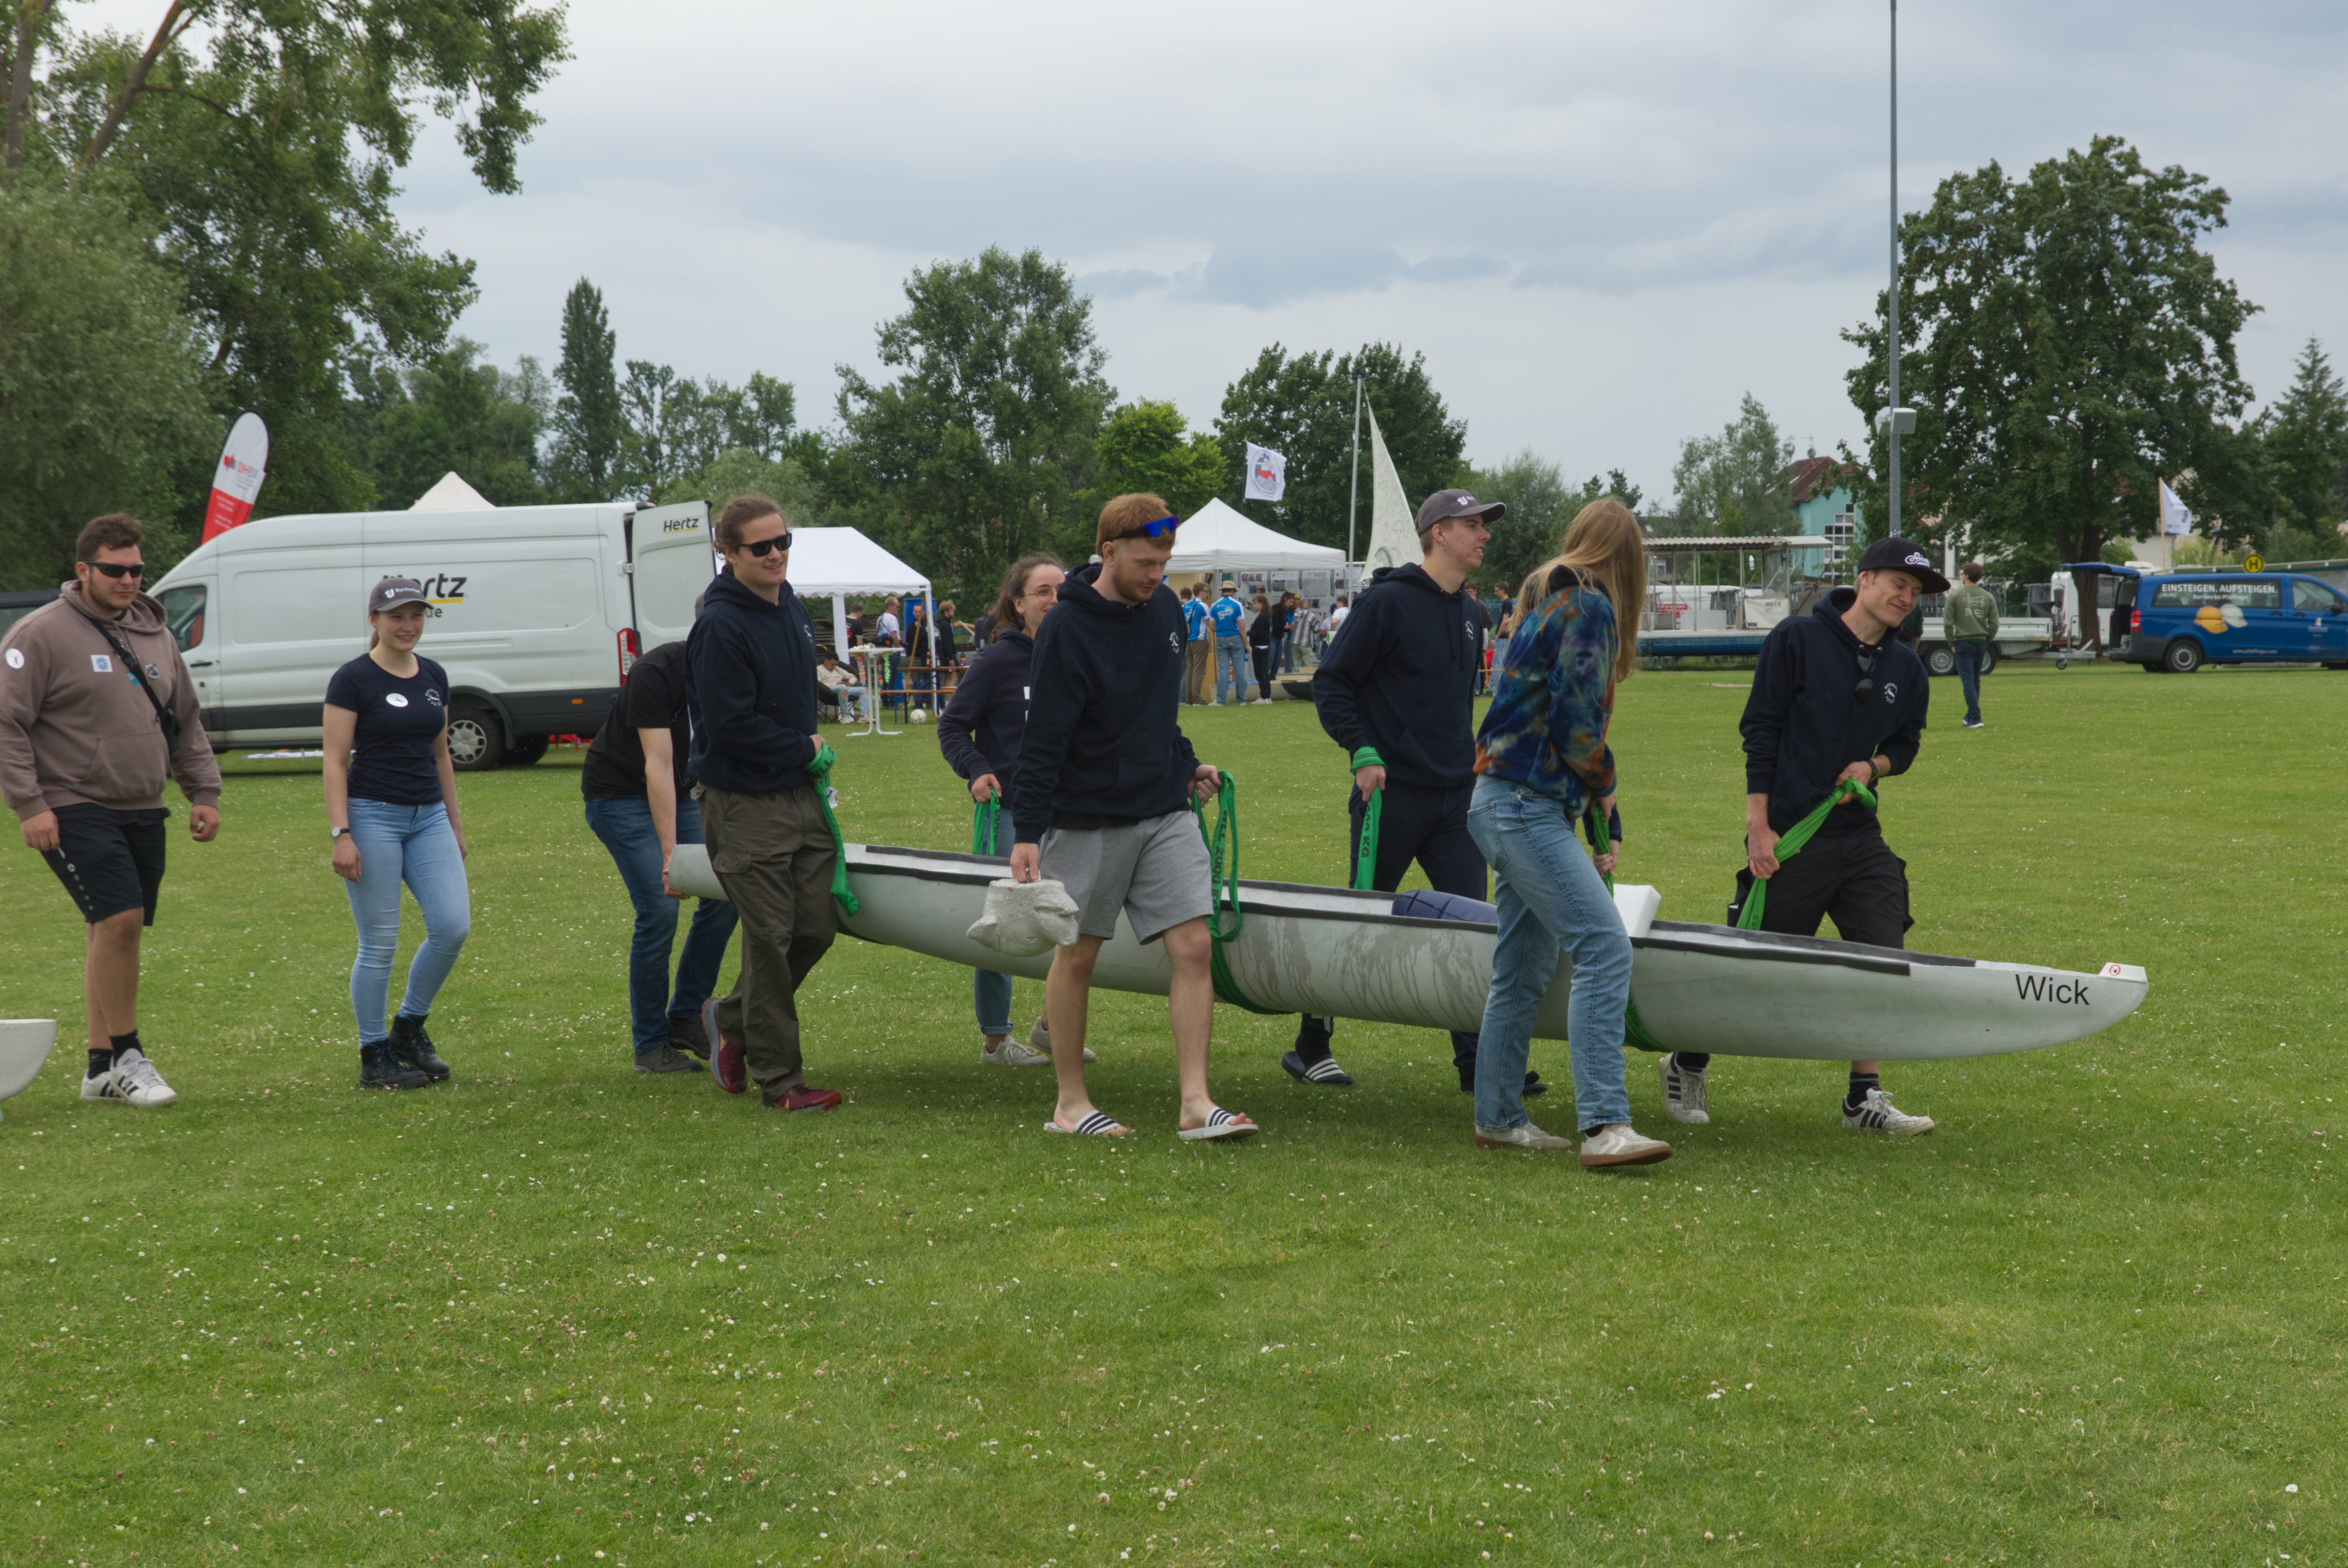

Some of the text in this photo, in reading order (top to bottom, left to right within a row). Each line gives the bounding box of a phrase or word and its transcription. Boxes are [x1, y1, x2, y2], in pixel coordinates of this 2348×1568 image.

[664, 517, 699, 532] Hertz
[2249, 559, 2258, 570] H
[2162, 583, 2278, 593] EINSTEIGEN. AUFSTEIGEN.
[1361, 836, 1370, 858] KG
[1212, 846, 1223, 884] 2000
[2015, 974, 2090, 1006] Wick
